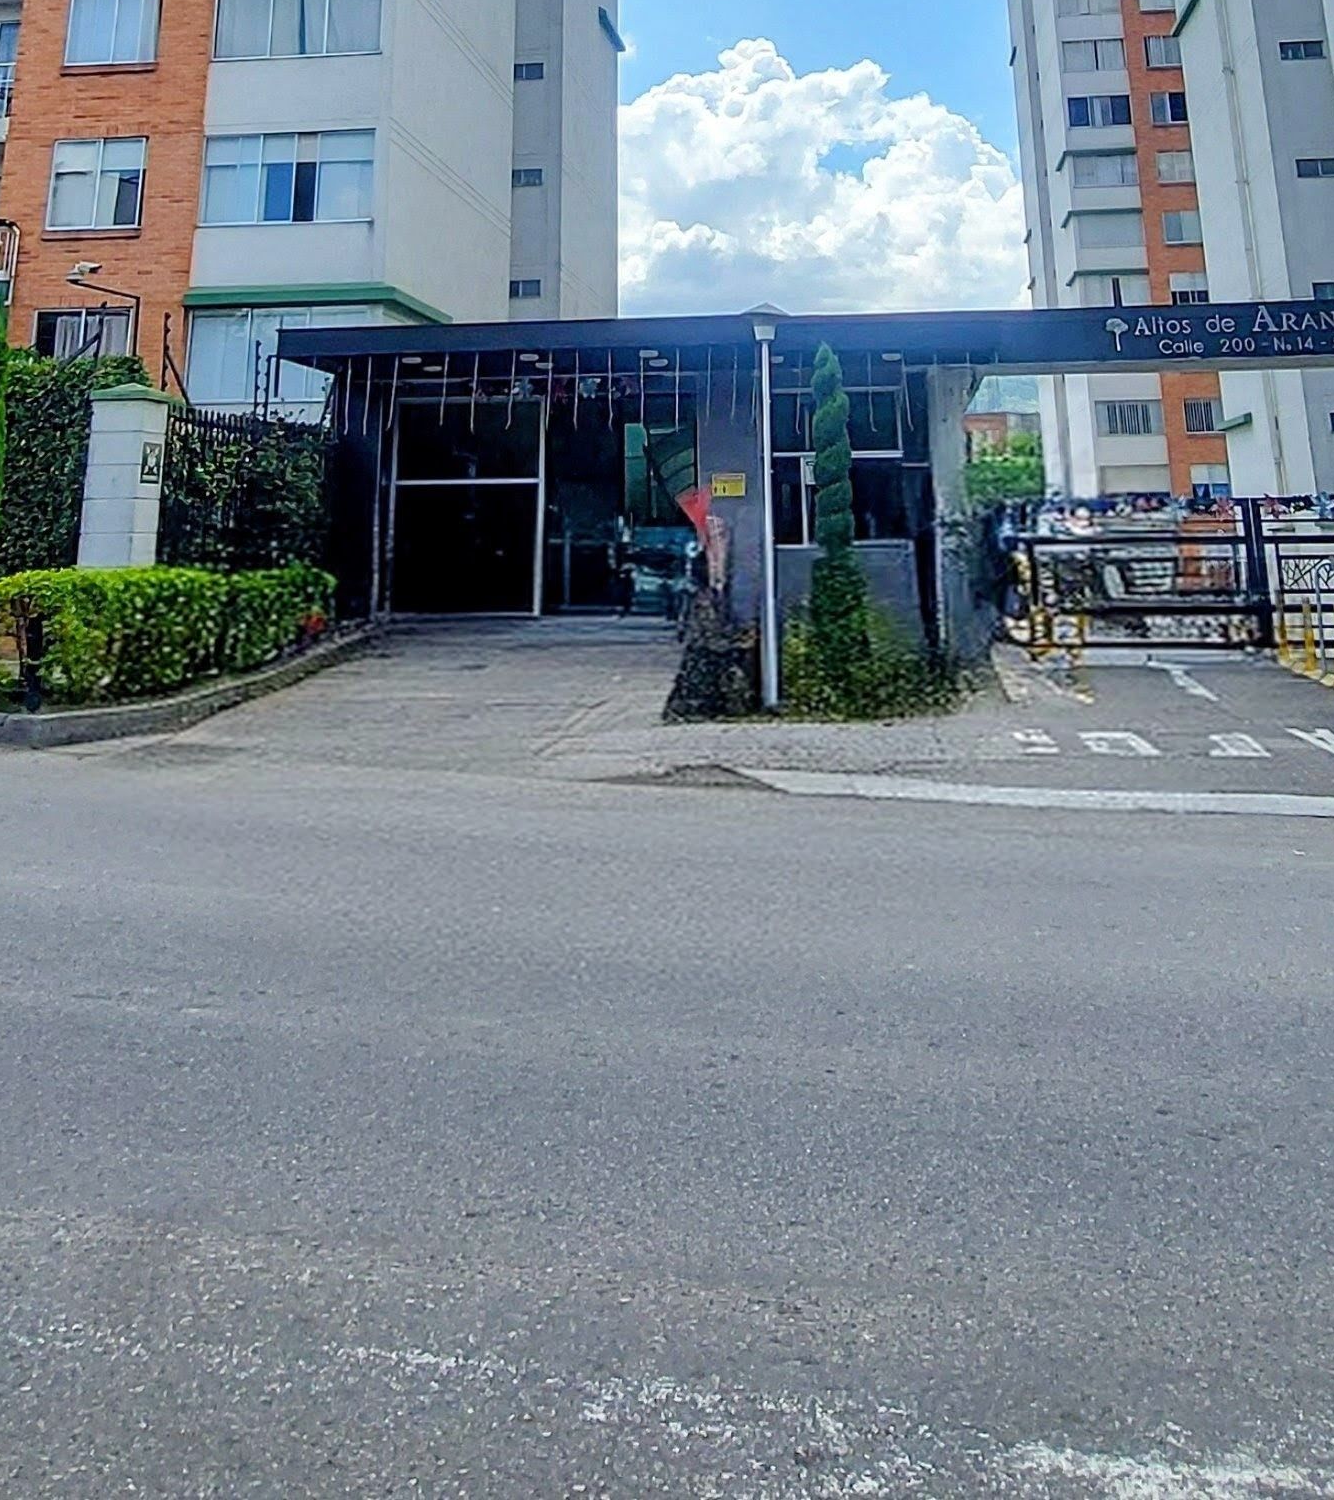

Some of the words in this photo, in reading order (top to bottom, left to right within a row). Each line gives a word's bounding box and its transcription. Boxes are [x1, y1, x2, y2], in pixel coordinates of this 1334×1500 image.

[1134, 315, 1192, 336] Altos
[1205, 314, 1236, 333] de
[1158, 339, 1205, 354] Calle
[1219, 337, 1255, 353] 200
[1297, 336, 1314, 350] 14
